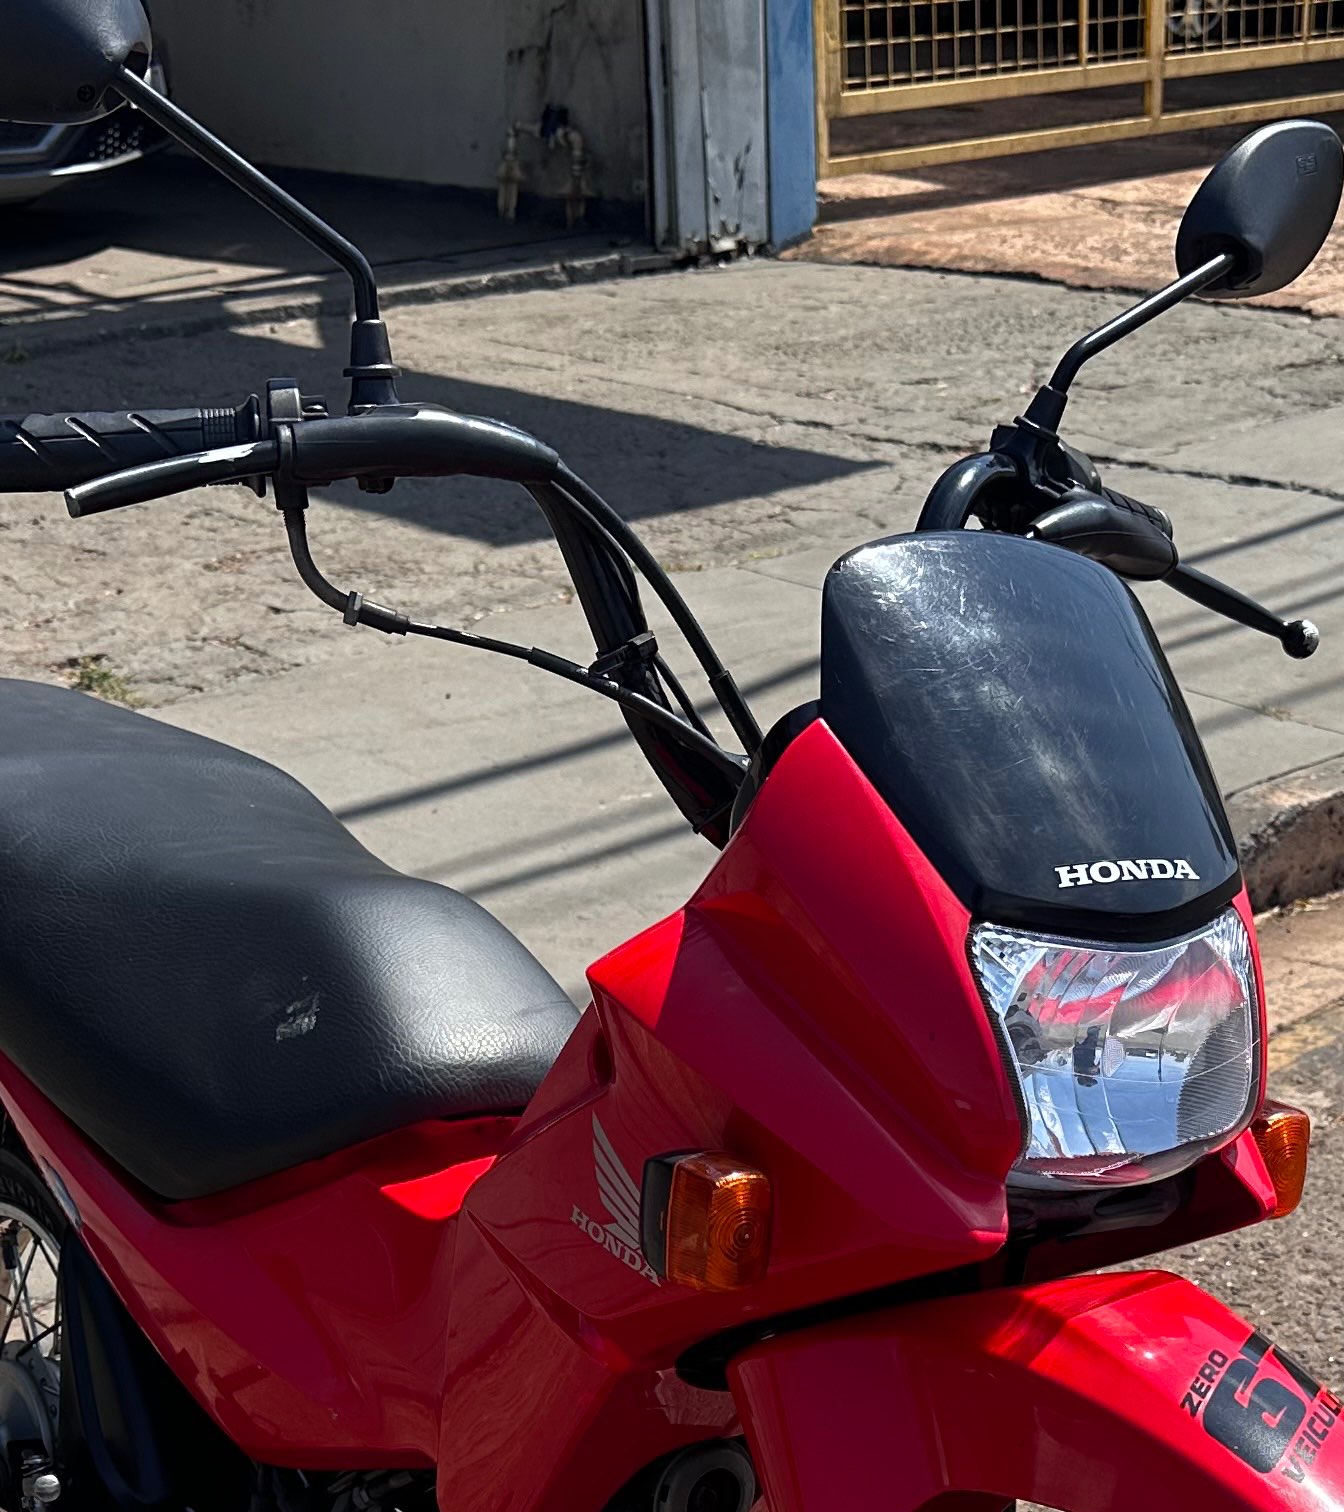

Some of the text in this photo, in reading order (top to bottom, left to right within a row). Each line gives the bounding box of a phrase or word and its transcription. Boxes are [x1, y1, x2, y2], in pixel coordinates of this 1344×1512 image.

[1054, 859, 1201, 888] HONDA
[570, 1204, 661, 1287] HONDA
[1180, 1349, 1230, 1418] ZERO
